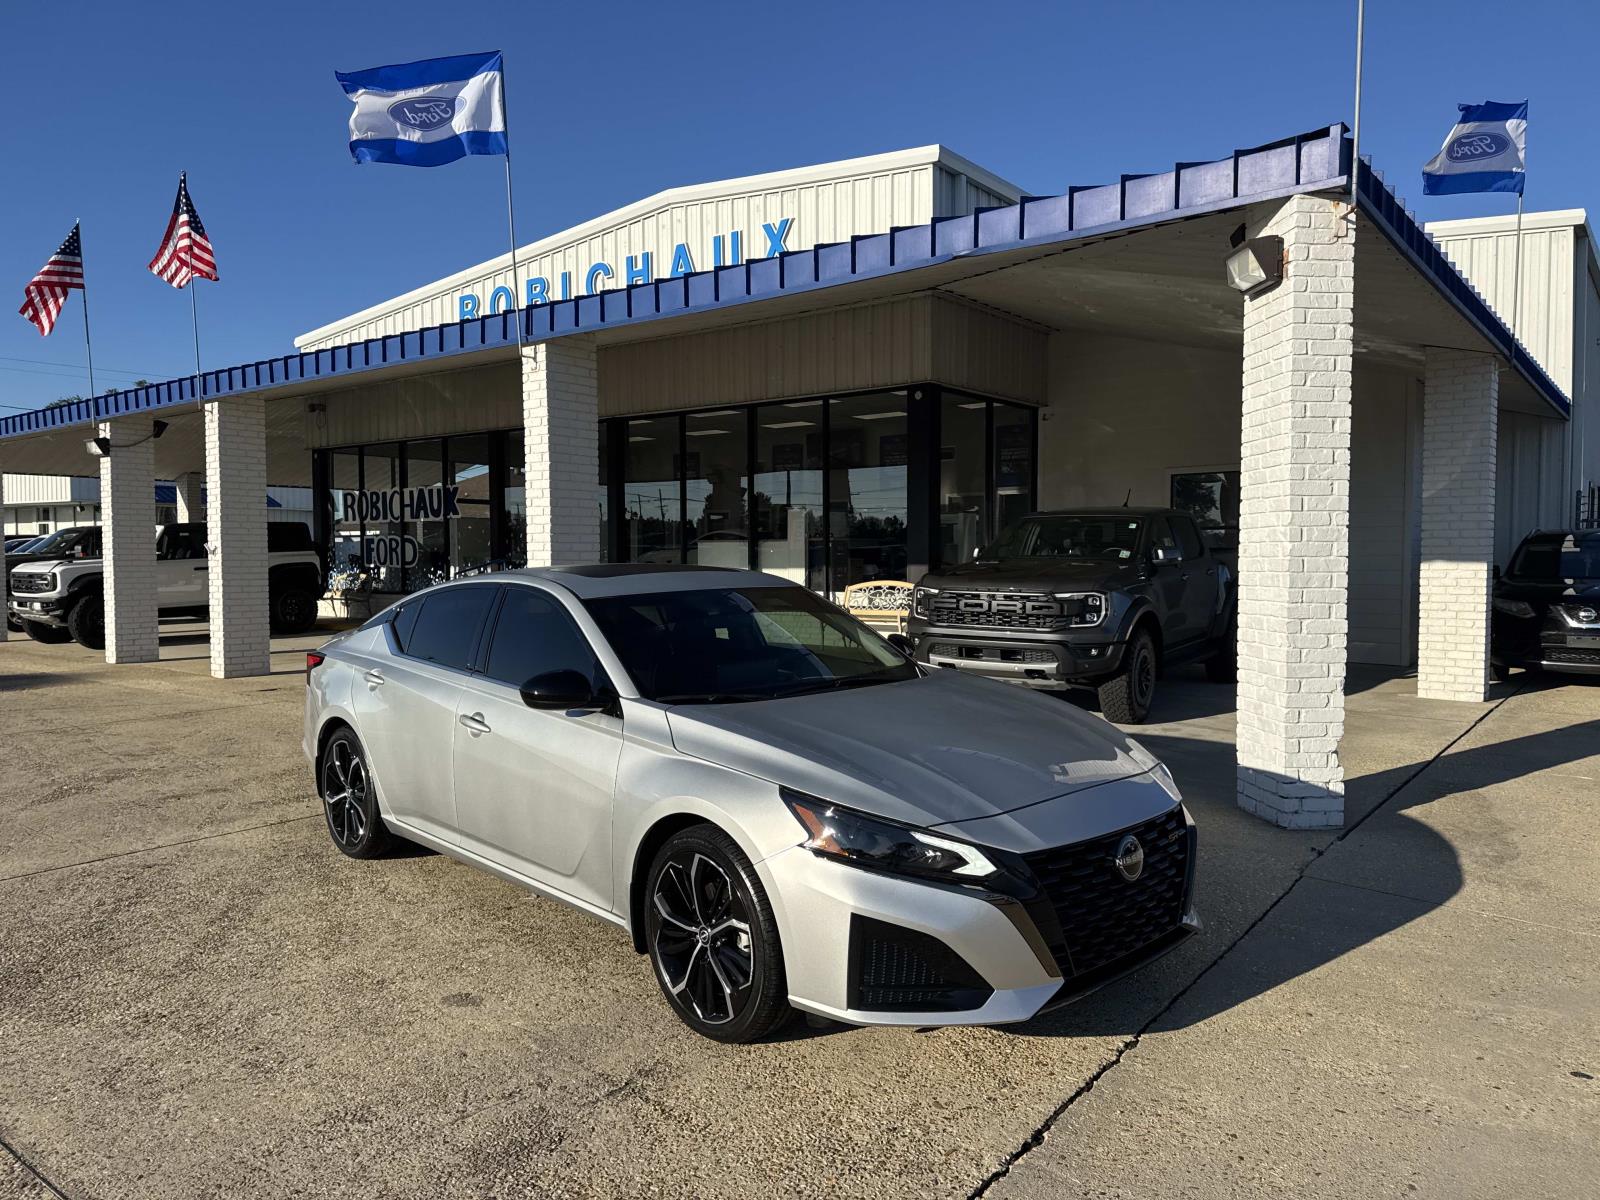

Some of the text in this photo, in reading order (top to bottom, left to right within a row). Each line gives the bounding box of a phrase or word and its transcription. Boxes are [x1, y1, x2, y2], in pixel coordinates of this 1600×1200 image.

[459, 217, 795, 320] ROBICHAUX
[342, 485, 461, 523] ROBICHAUX
[364, 535, 419, 568] FORD
[928, 598, 1065, 616] FORD
